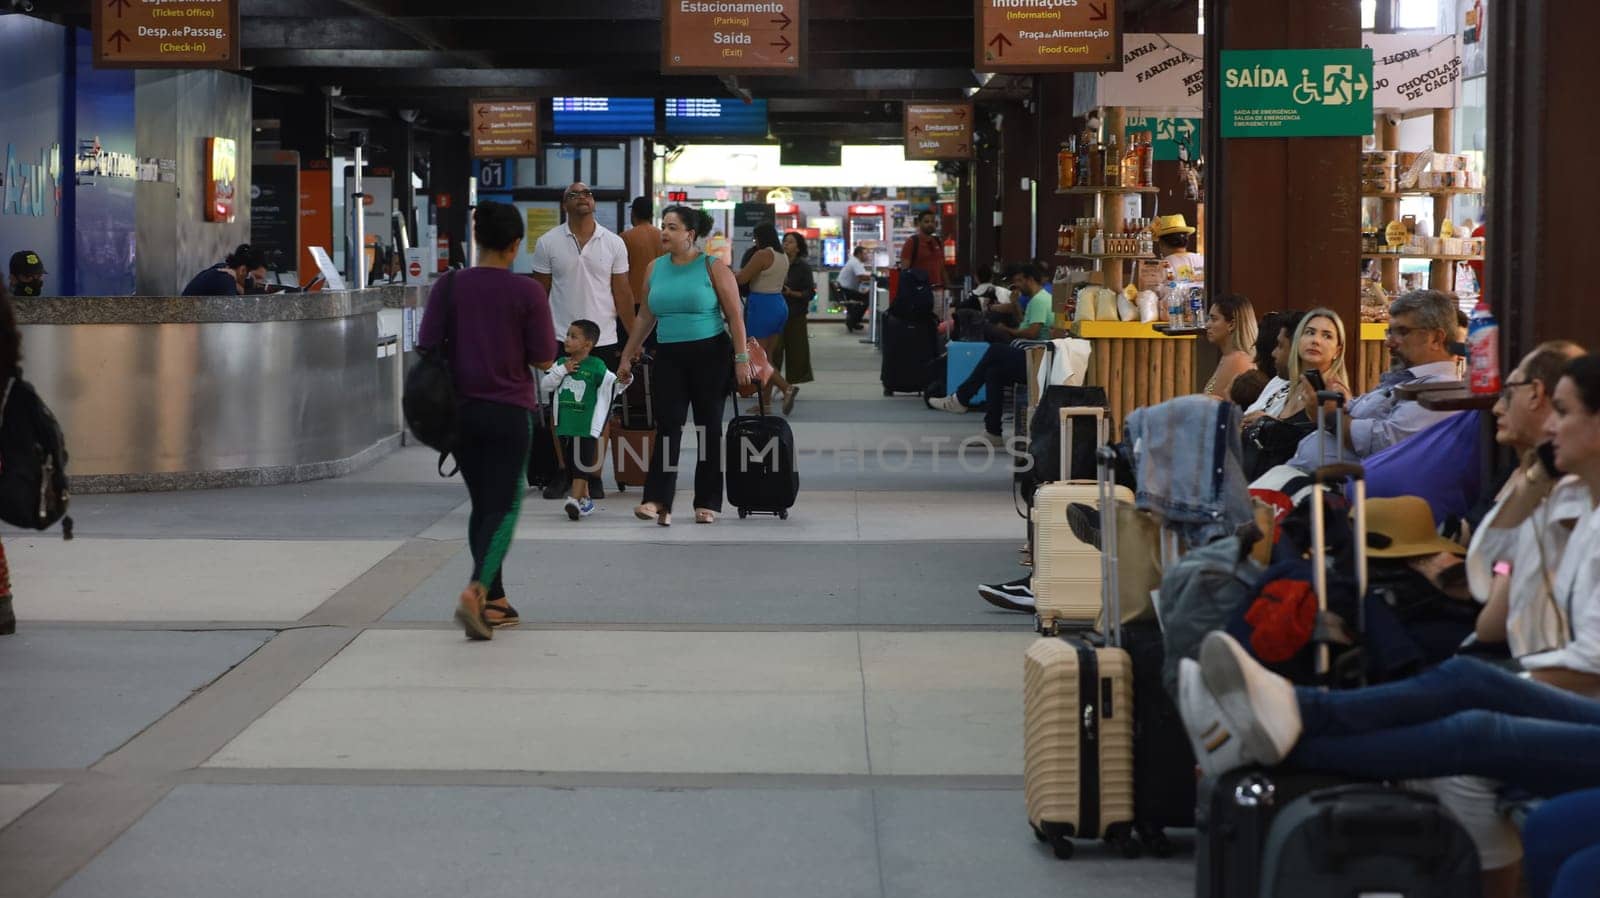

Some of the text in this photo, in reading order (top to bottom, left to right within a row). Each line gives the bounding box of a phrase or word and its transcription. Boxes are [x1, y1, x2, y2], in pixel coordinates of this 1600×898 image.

[152, 8, 215, 18] (Tickets Office)
[681, 1, 784, 13] Estacionamento
[714, 17, 750, 26] (Parking)
[1007, 11, 1061, 20] (Information)
[138, 26, 227, 39] Desp. de Passag.
[713, 32, 752, 44] Saída
[1019, 30, 1045, 40] Praça
[1052, 29, 1110, 39] Alimentação
[160, 43, 206, 53] (Check-in)
[722, 48, 743, 57] (Exit)
[1038, 44, 1089, 56] (Food Court)
[1122, 42, 1157, 64] ANHA
[1382, 49, 1419, 65] LICOR
[1136, 52, 1190, 83] FARINHA
[1226, 64, 1288, 88] SAÍDA
[1397, 56, 1462, 94] CHOCOLATE
[1188, 80, 1205, 96] AB
[1374, 79, 1389, 90] JO
[1406, 68, 1460, 100] DE CACAU
[925, 124, 959, 132] Embarque
[4, 143, 48, 217] Azul
[482, 166, 502, 186] 01
